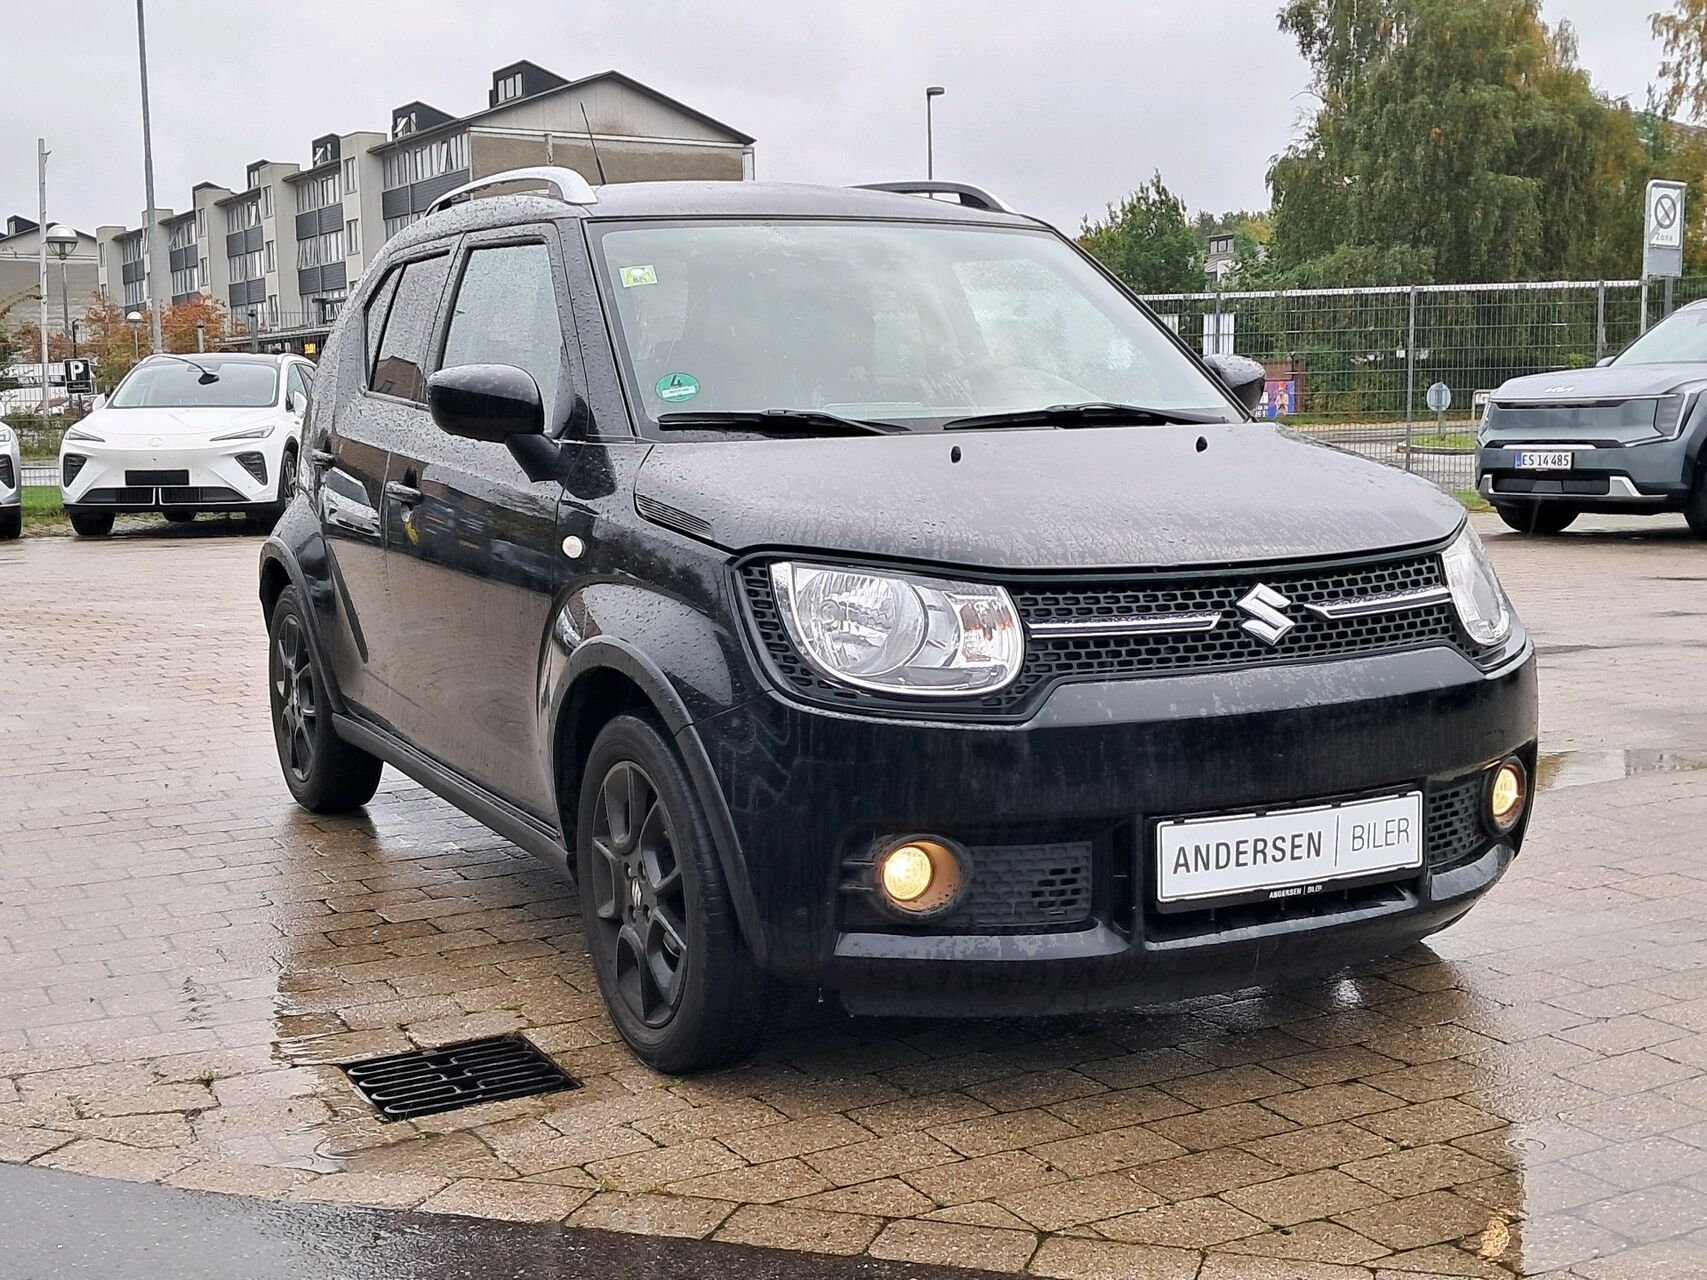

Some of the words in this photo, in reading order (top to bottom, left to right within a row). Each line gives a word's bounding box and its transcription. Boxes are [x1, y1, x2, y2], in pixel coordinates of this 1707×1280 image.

[70, 361, 84, 381] P
[670, 374, 683, 387] 4
[1522, 454, 1535, 466] ES
[1537, 454, 1549, 466] 14
[1550, 454, 1569, 466] 485
[1172, 830, 1322, 875] ANDERSEN
[1351, 817, 1410, 852] BILER
